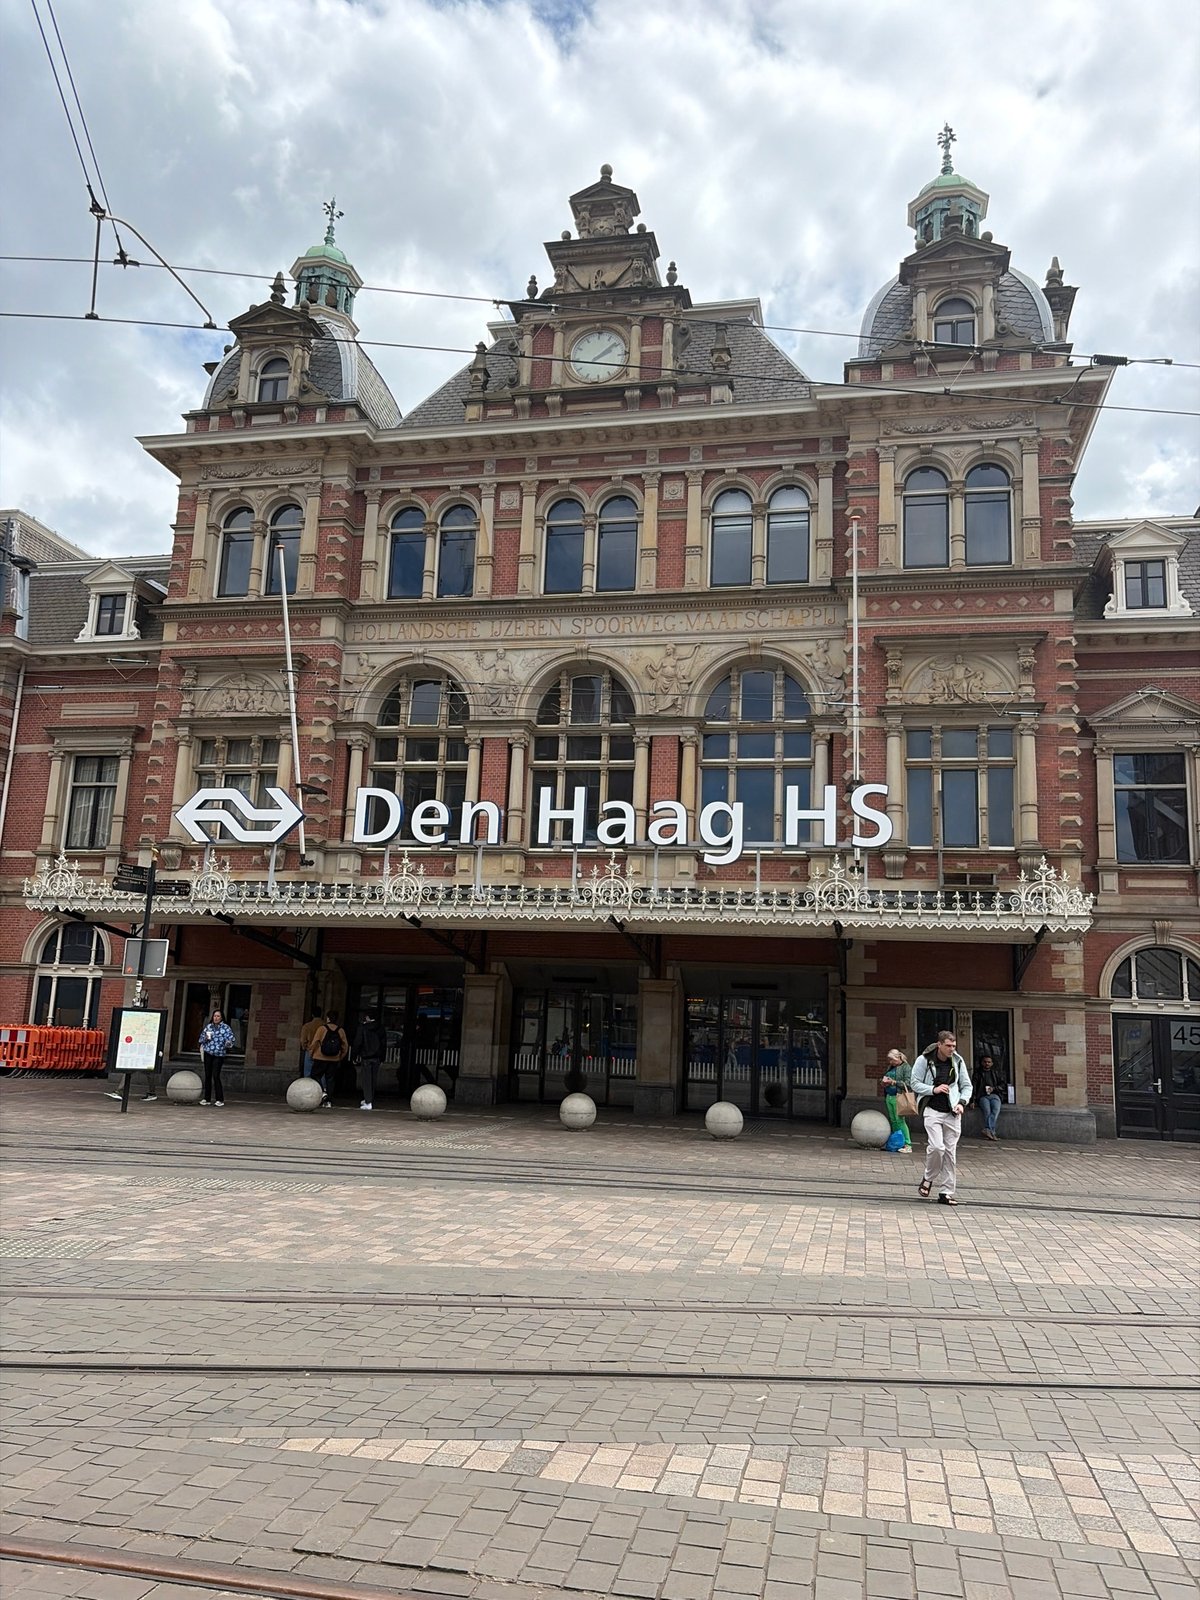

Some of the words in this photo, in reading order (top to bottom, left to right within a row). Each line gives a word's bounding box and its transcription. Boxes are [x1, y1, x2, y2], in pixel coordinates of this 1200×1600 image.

[351, 620, 481, 641] HOLLANDSCHE
[490, 618, 562, 639] IJZEREN
[353, 786, 502, 845] Den
[537, 785, 744, 865] Haag
[785, 783, 894, 847] HS
